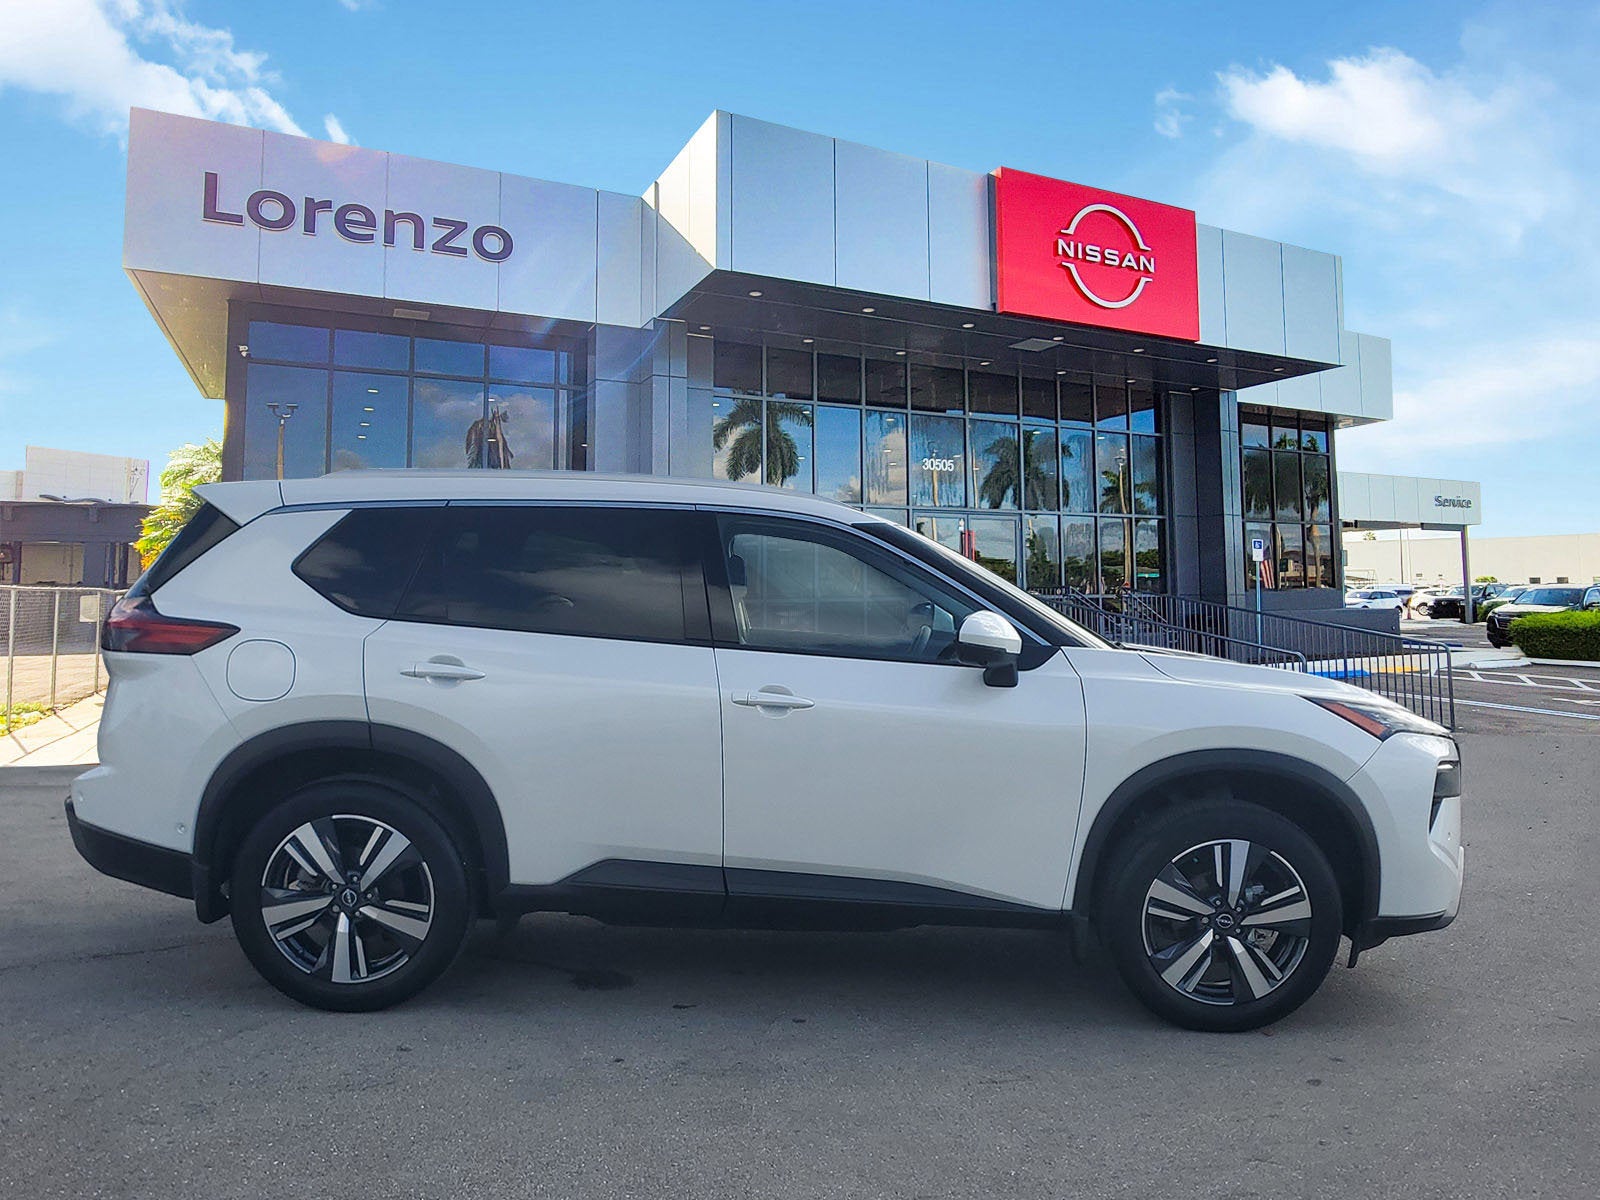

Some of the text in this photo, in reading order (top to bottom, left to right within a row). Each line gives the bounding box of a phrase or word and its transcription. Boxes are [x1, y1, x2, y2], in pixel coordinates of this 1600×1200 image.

[202, 171, 514, 262] Lorenzo
[1057, 238, 1155, 273] NISSAN
[922, 457, 955, 472] 30505
[1434, 495, 1472, 508] Service
